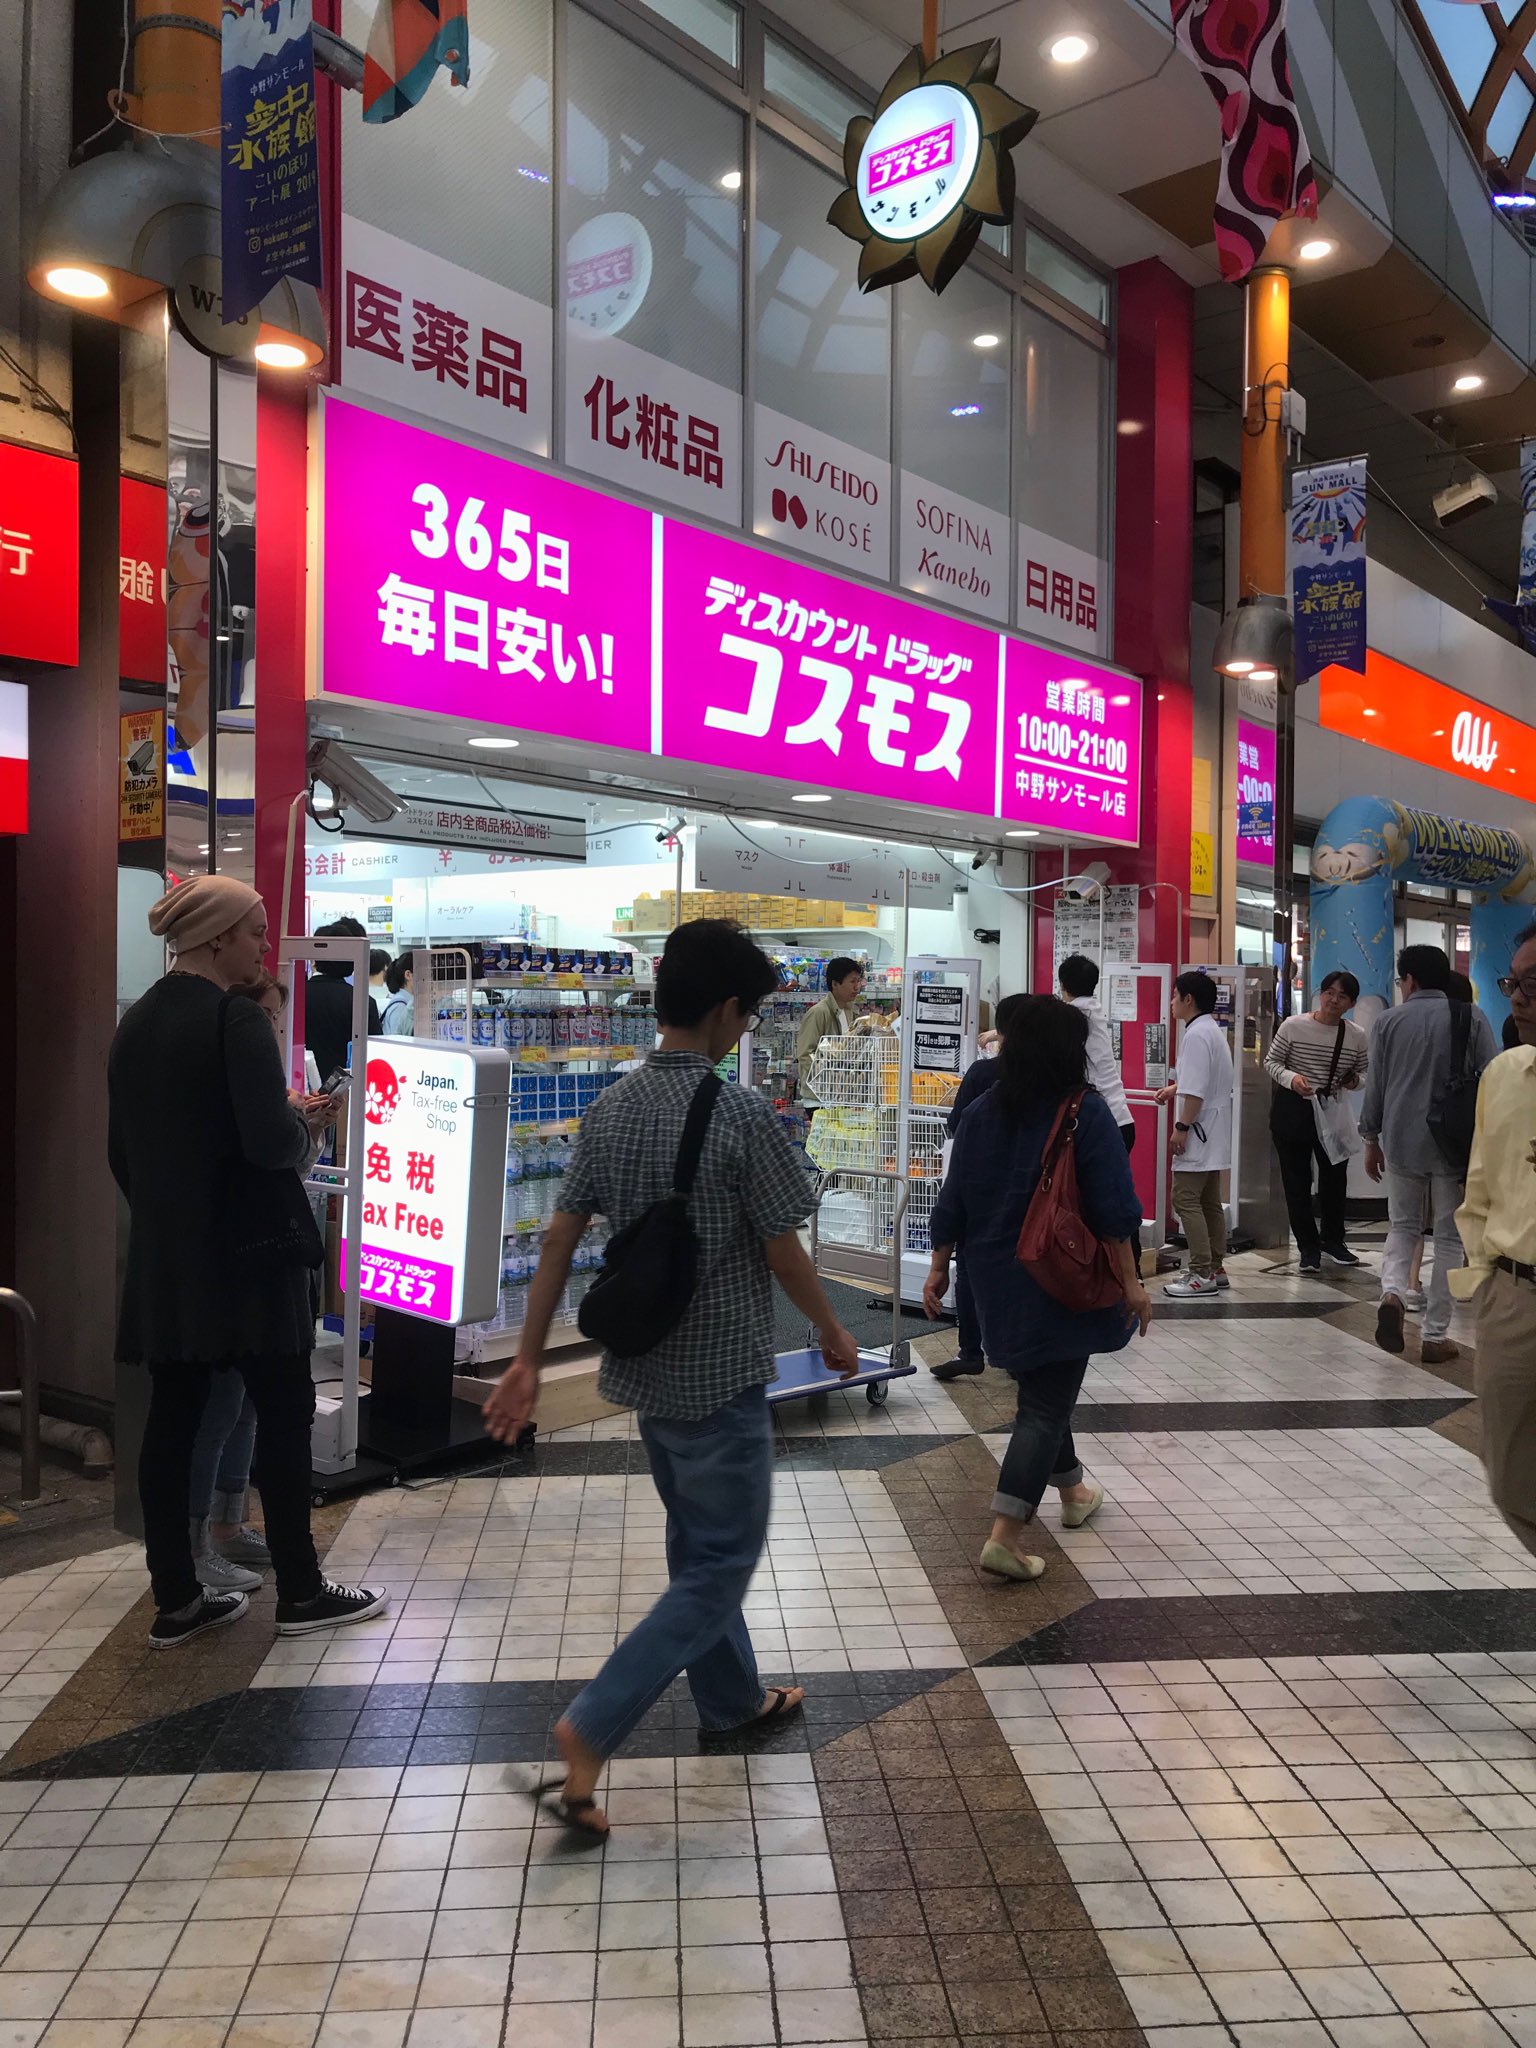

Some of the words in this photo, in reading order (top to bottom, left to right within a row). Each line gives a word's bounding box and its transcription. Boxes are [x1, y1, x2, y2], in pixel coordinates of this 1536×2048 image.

[250, 58, 304, 96] 中野サンモール
[245, 83, 308, 136] 空中
[228, 101, 315, 170] 水族館
[871, 139, 950, 189] コスモス
[870, 178, 946, 223] サンモール
[346, 270, 527, 414] 医薬品
[584, 375, 723, 489] 化粧品
[764, 440, 878, 506] SHISEIDO
[1301, 483, 1324, 494] SUN
[1328, 477, 1358, 489] MALL
[410, 482, 569, 595] 365日
[815, 509, 872, 553] KOSÉ
[916, 499, 992, 555] SOFINA
[918, 548, 991, 598] Kanebo
[1026, 559, 1097, 632] 日用品
[1297, 591, 1364, 615] 水族館
[377, 572, 614, 695] 毎日安い!
[704, 576, 877, 661] ディスカウント
[883, 634, 973, 684] ドラッグ
[127, 713, 156, 729] WARNING!
[703, 632, 972, 782] コスモス
[1046, 680, 1106, 724] 営業時間
[1017, 712, 1128, 774] 10:00-21:00
[1452, 710, 1498, 773] au
[124, 777, 158, 792] 防犯カメラ
[1015, 769, 1127, 817] 中野サンモール店
[129, 800, 155, 816] 作動中!
[436, 811, 551, 840] 店内全商品税込価格!
[351, 854, 399, 867] CASHIER
[735, 849, 759, 862] マスク
[898, 869, 941, 883] カロ・殺虫剤
[437, 905, 475, 915] オーラルケア
[916, 1034, 959, 1046] 万引きは犯罪です
[411, 1091, 458, 1114] Tax-free
[416, 1070, 458, 1091] Japan.
[426, 1113, 457, 1136] Shop
[362, 1195, 388, 1228] ax
[394, 1202, 445, 1241] Free
[360, 1264, 436, 1309] コスモス
